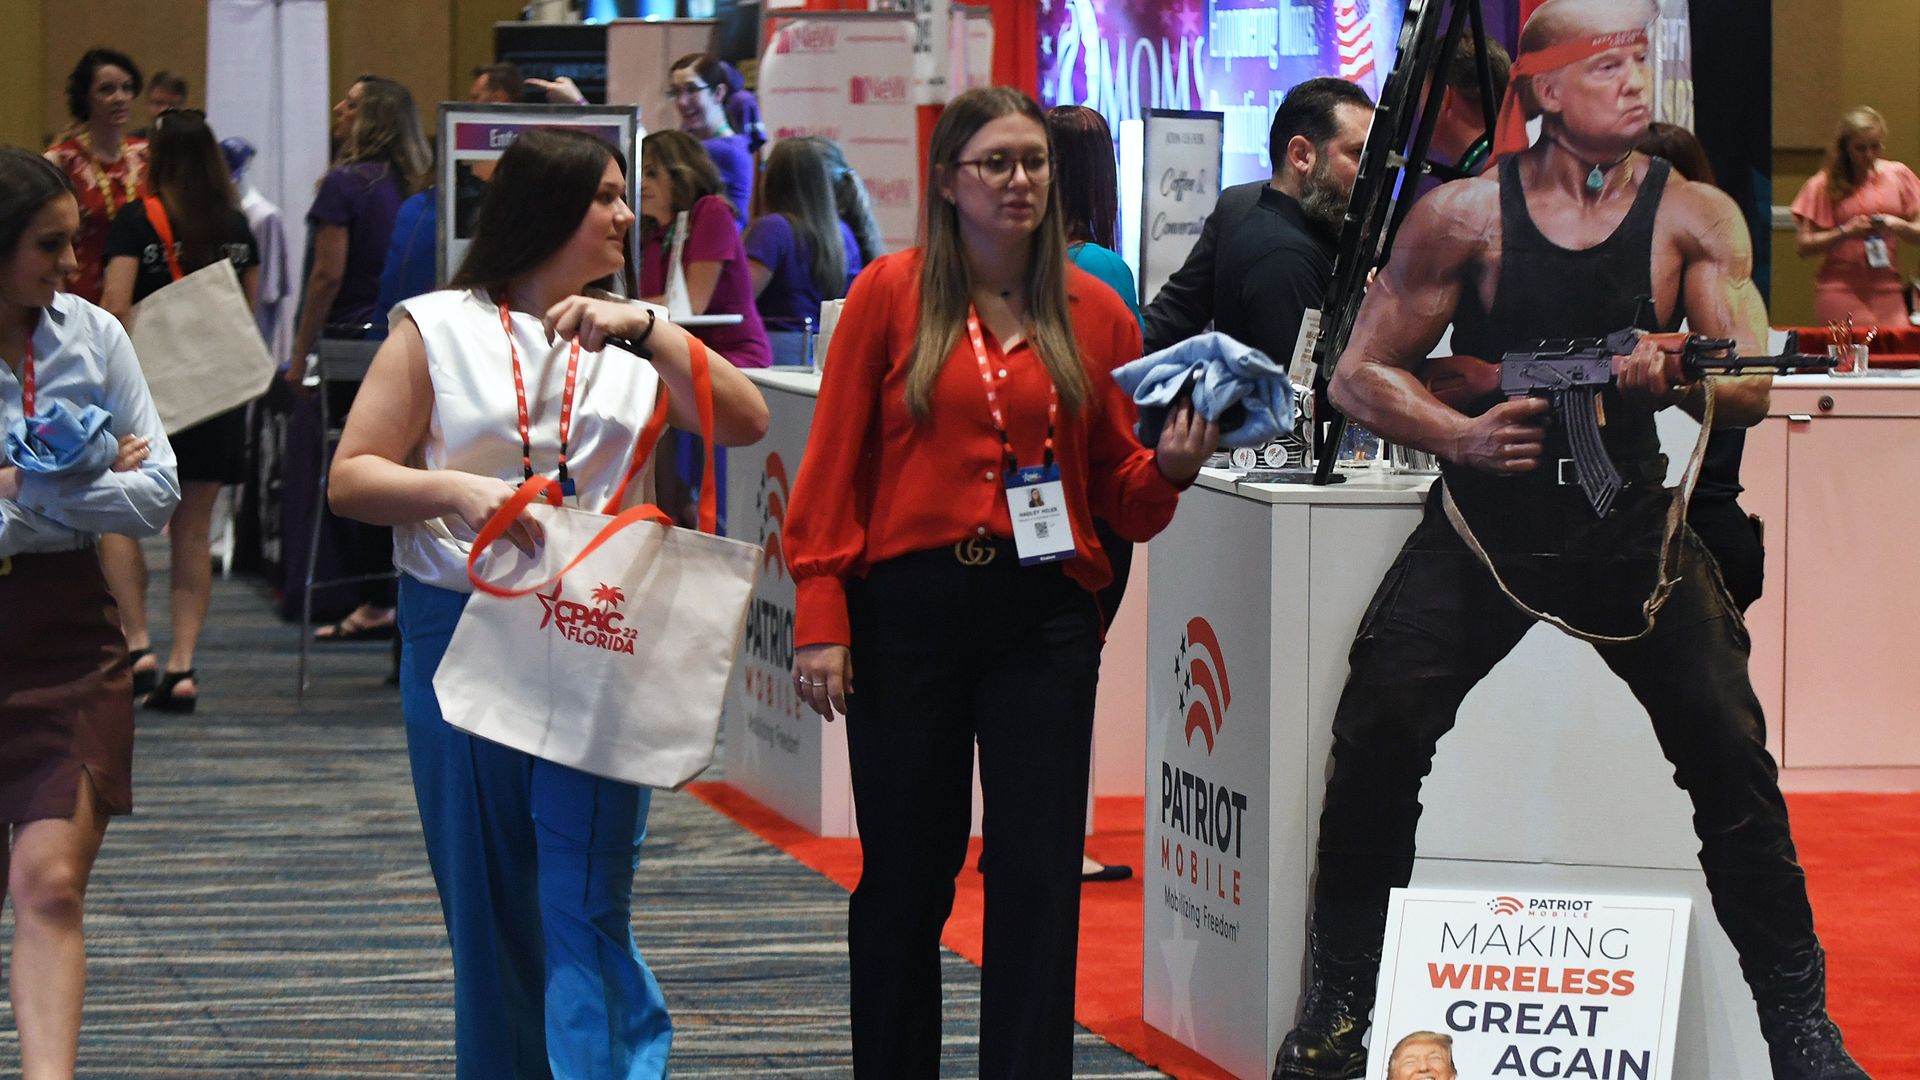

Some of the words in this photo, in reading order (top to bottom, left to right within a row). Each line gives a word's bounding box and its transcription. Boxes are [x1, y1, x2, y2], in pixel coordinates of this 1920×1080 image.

[554, 600, 625, 635] CPAC
[622, 627, 638, 639] 22
[746, 598, 794, 672] PATRIO
[567, 625, 634, 655] FLORIDA
[1161, 760, 1247, 859] PATRIOT
[1161, 834, 1241, 906] MOBILE
[1164, 884, 1200, 929] Mobilizing
[1528, 910, 1589, 919] MOBILE
[1529, 898, 1593, 912] PATRIOT
[1440, 921, 1630, 960] MAKING
[1427, 962, 1635, 997] WIRELESS
[1445, 1000, 1609, 1038] GREAT
[1491, 1044, 1651, 1080] AGAIN
